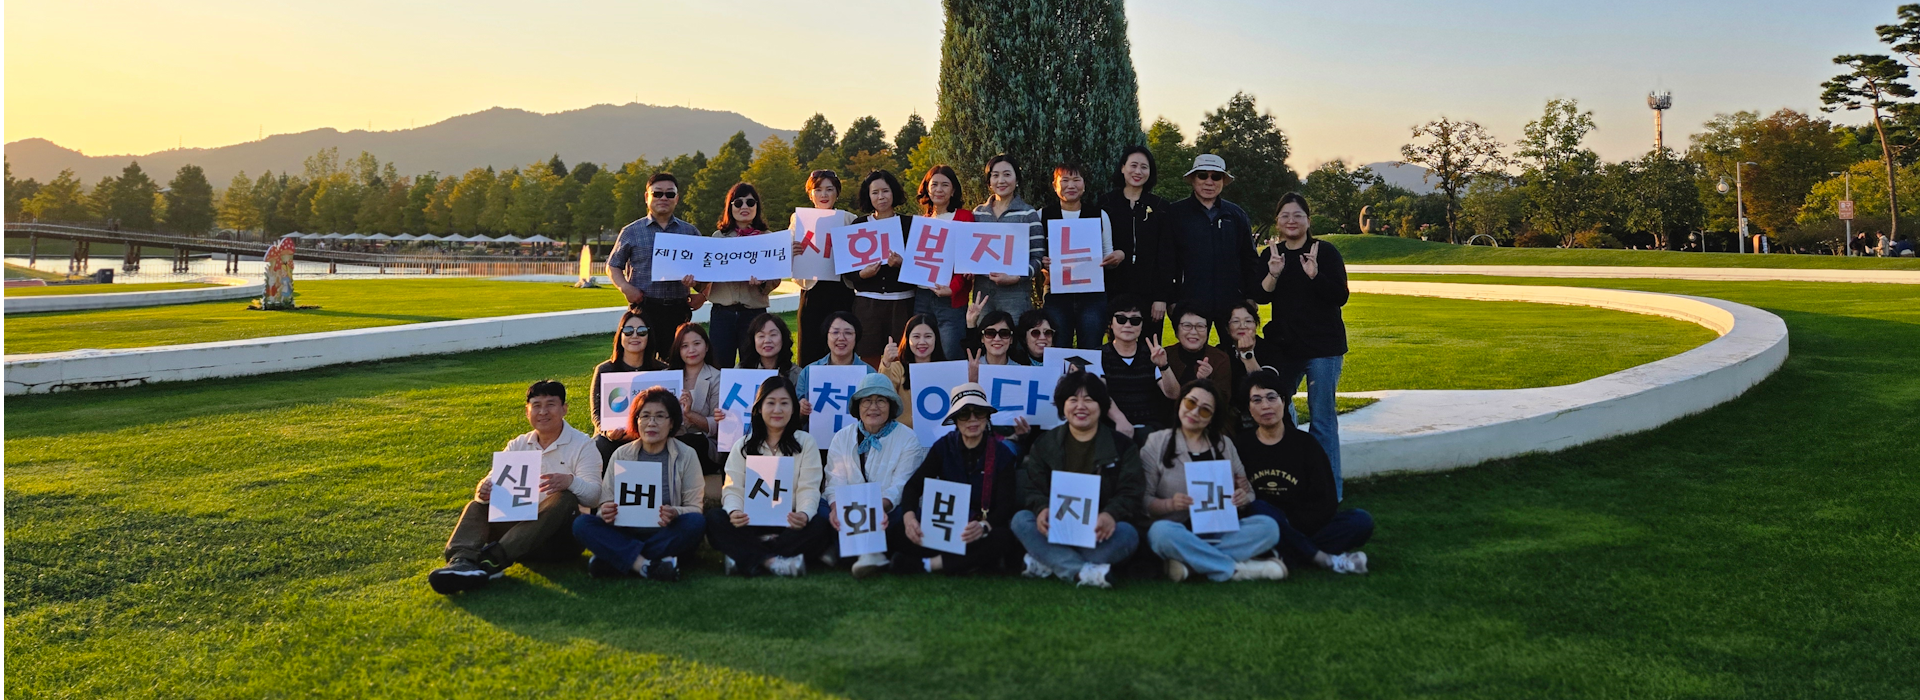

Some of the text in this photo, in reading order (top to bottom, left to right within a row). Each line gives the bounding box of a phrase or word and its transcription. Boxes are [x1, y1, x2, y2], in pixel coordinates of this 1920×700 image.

[654, 248, 693, 261] 제1회
[847, 228, 890, 268] 회
[914, 224, 949, 283] 복
[970, 233, 1015, 266] 지
[1060, 226, 1093, 286] 는
[990, 377, 1050, 416] 다
[495, 464, 533, 508] 실
[619, 482, 656, 509] 버
[748, 478, 788, 501] 사
[1191, 481, 1232, 513] 과
[843, 501, 877, 536] 회
[931, 491, 956, 542] 복
[1055, 494, 1092, 525] 지
